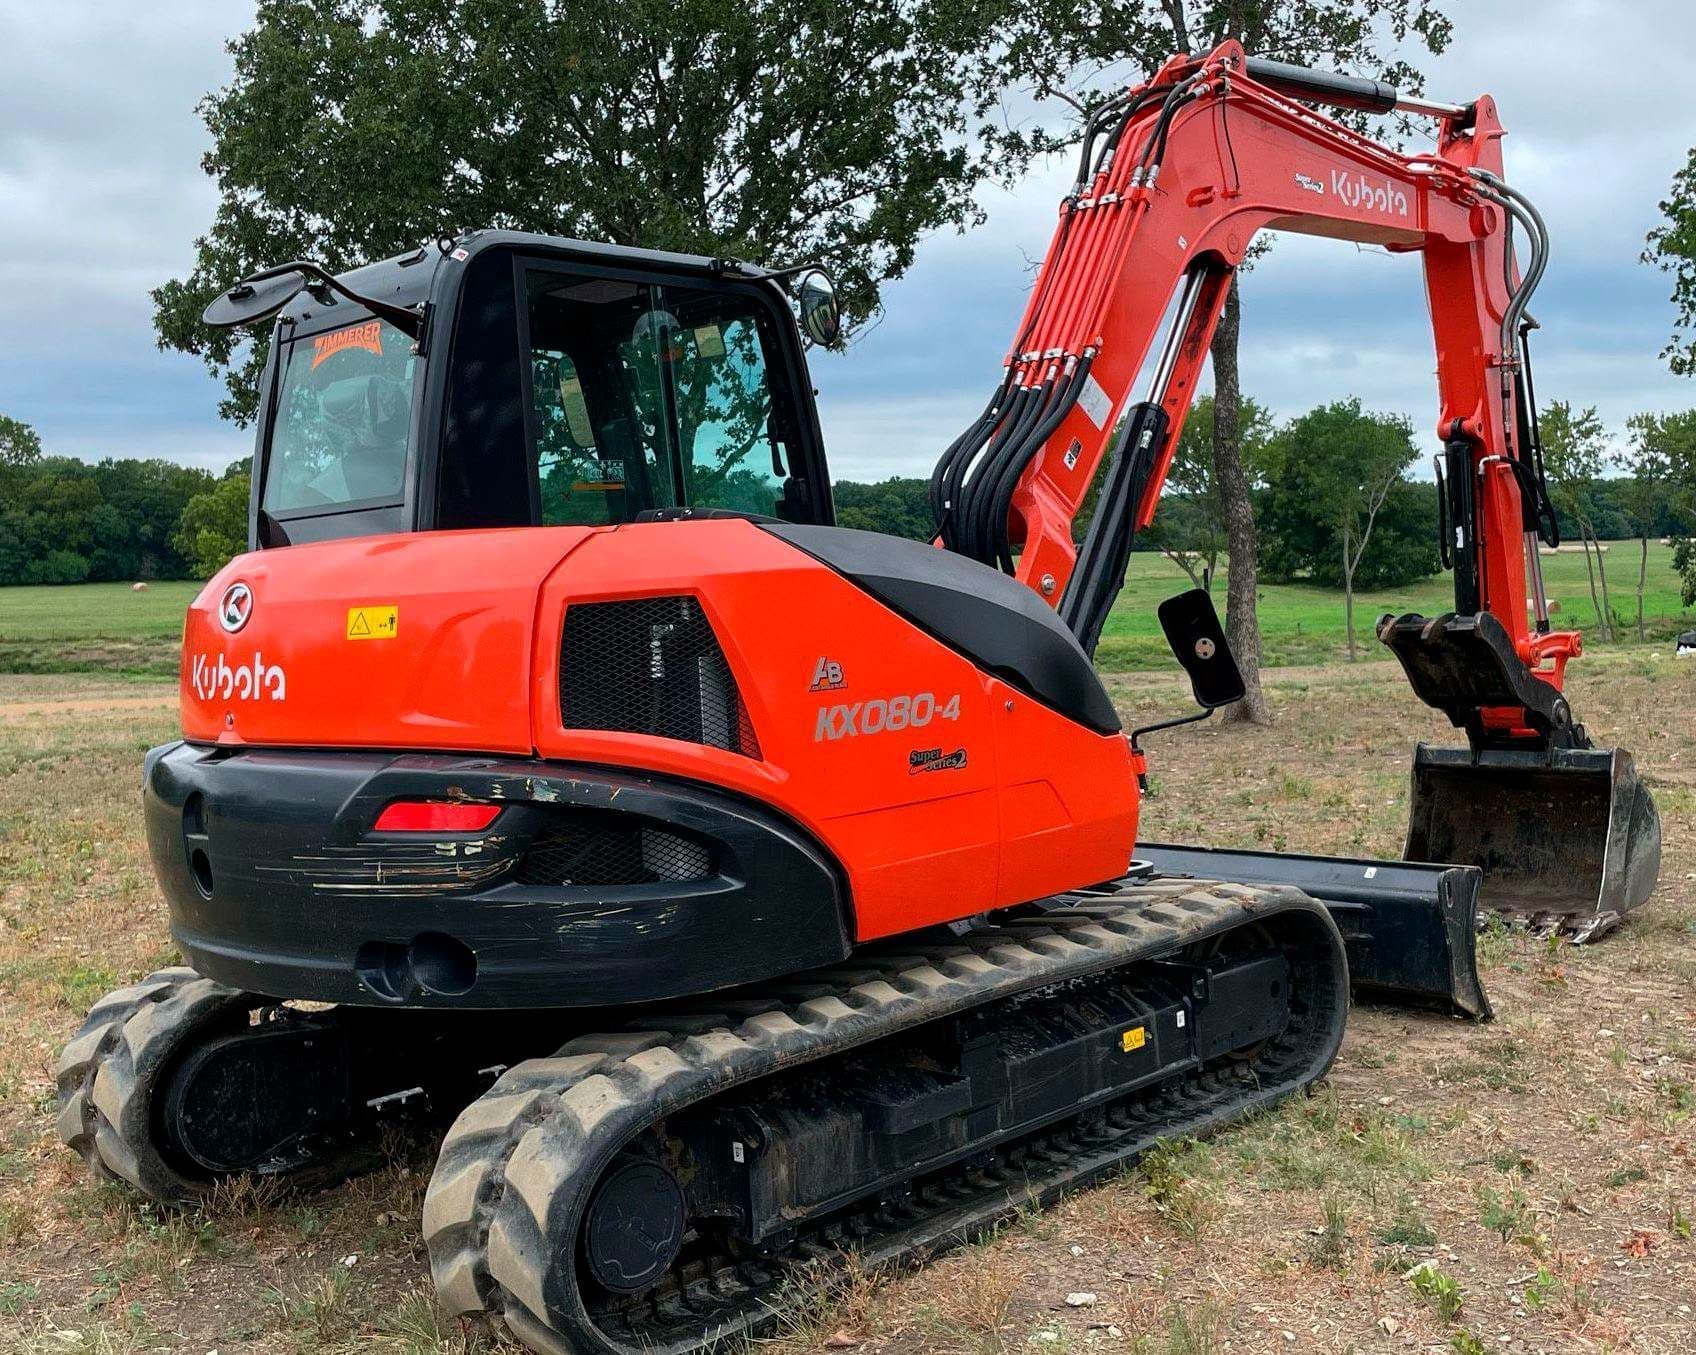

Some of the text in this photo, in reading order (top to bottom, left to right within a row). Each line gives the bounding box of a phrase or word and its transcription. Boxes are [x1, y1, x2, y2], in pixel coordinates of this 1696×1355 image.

[1331, 169, 1407, 216] Kubota
[313, 321, 383, 365] ZIMMERER
[193, 651, 286, 700] Kubota
[815, 693, 961, 742] KX080-4
[911, 750, 940, 763] Super
